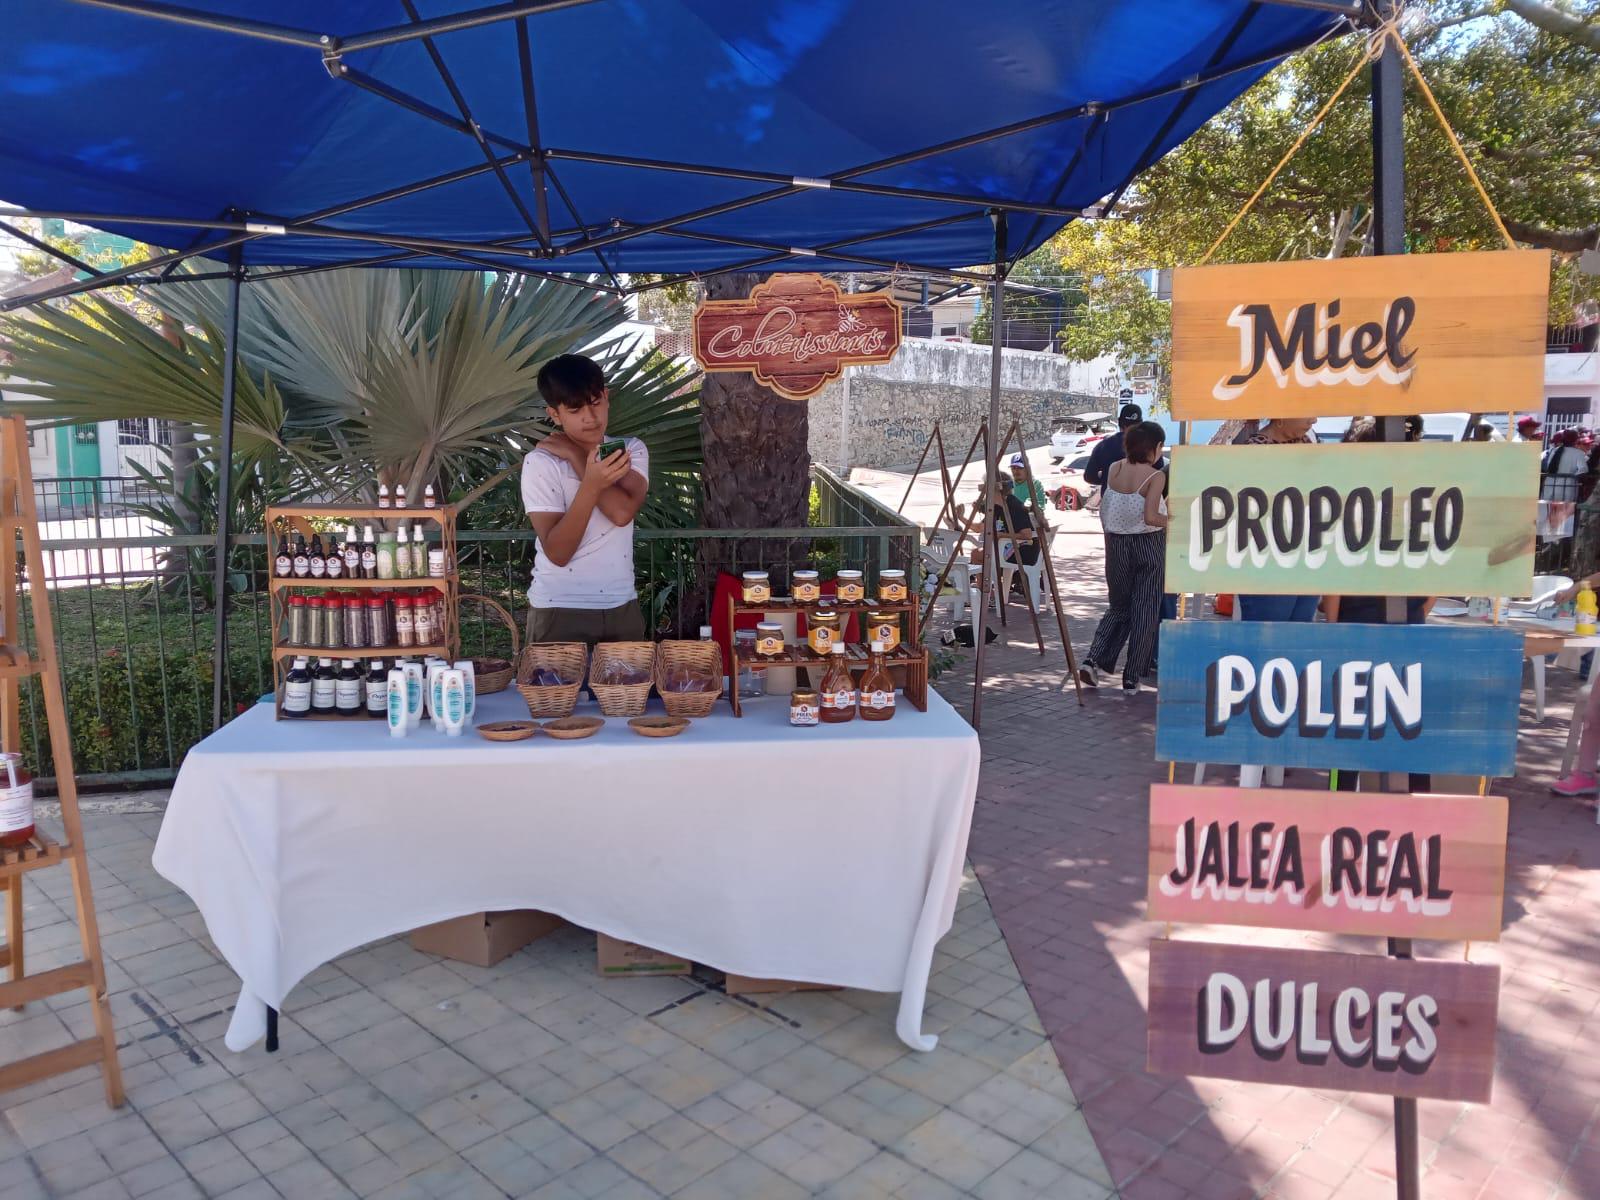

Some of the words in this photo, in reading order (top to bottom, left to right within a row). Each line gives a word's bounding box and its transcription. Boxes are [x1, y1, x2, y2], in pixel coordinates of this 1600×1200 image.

[1214, 296, 1418, 400] Miel
[1190, 486, 1464, 571] PROPOLEO
[1206, 654, 1423, 740] POLEN
[1160, 816, 1305, 905] JALEA
[1321, 827, 1453, 916] REAL
[1199, 972, 1440, 1075] DULCES
